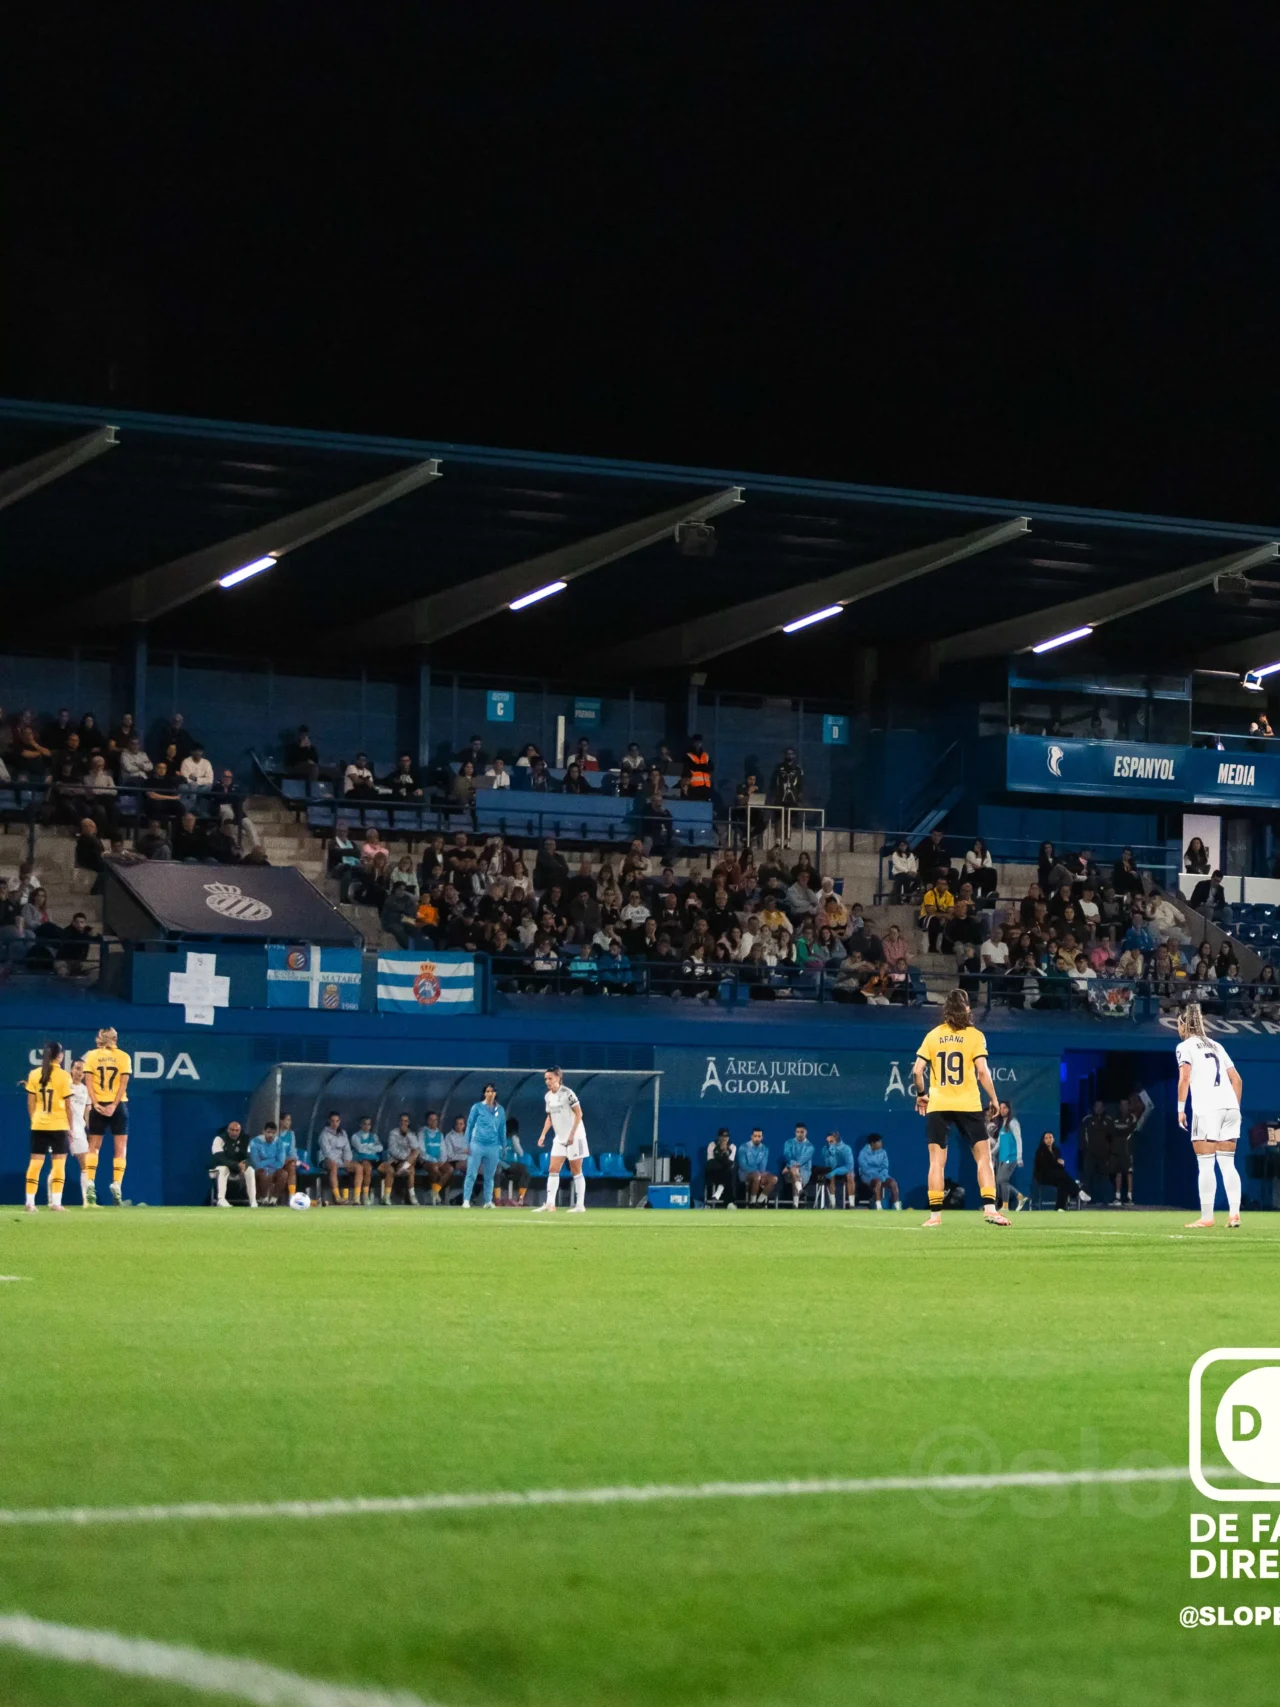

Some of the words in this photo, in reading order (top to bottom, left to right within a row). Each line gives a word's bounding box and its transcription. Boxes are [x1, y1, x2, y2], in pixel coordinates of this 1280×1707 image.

[497, 702, 504, 716] C
[832, 725, 839, 739] D
[1113, 756, 1175, 781] ESPANYOL
[1217, 762, 1255, 787] MEDIA
[96, 1065, 119, 1092] 17
[769, 1058, 840, 1079] JURÍDICA
[936, 1051, 964, 1087] 19
[1204, 1052, 1221, 1087] 7
[725, 1079, 791, 1095] GLOBAL
[39, 1088, 54, 1115] 11
